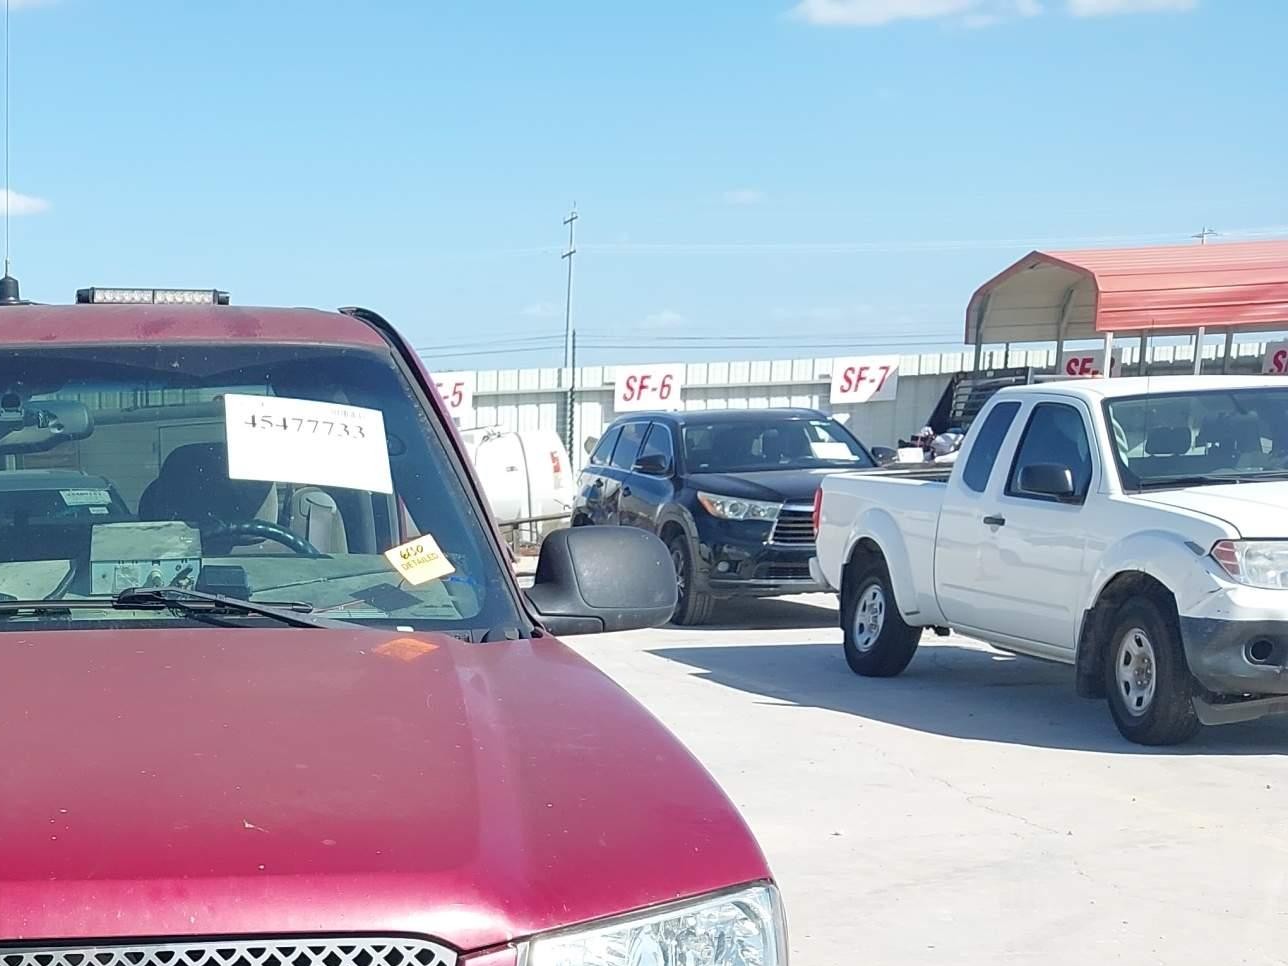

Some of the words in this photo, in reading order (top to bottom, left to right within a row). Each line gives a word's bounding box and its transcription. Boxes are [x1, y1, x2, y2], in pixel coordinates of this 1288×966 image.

[1066, 356, 1116, 377] SF-
[623, 374, 673, 402] SF-6
[839, 366, 890, 394] SF-7
[244, 413, 366, 439] 45477733
[400, 552, 439, 571] DETAILED
